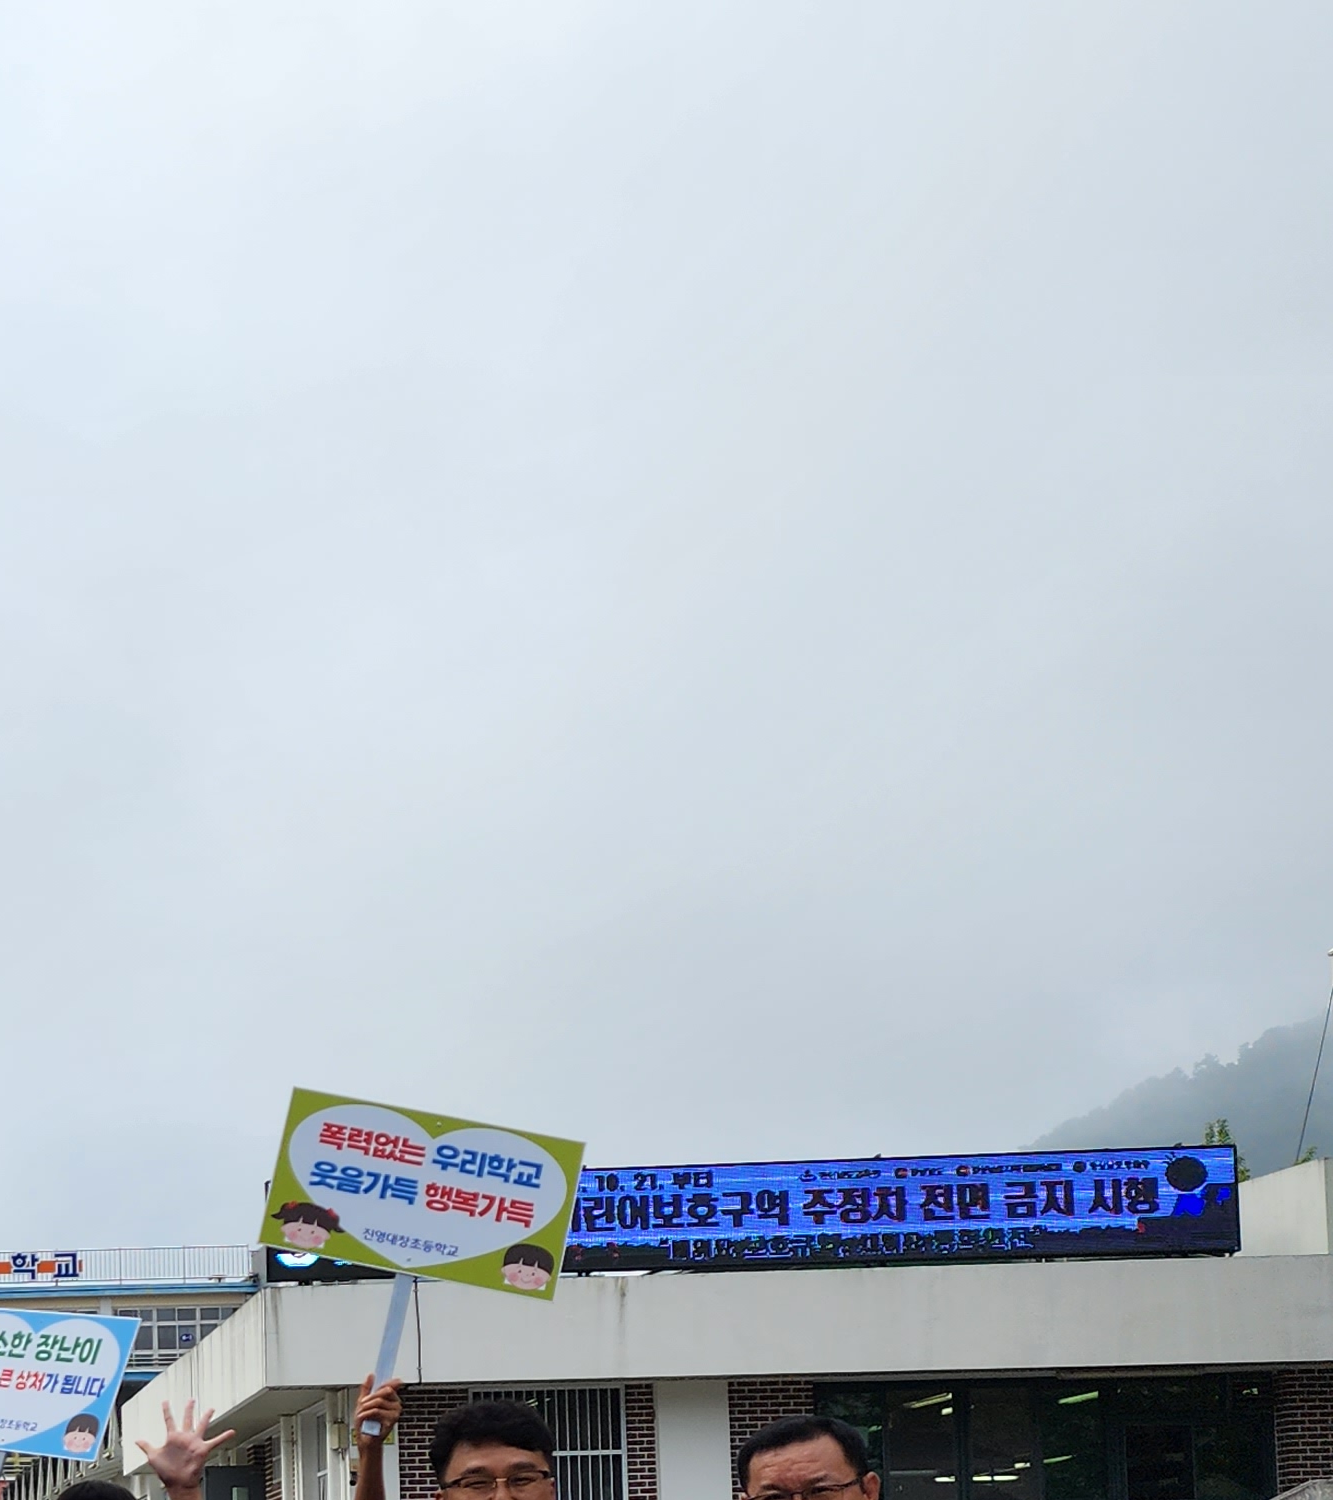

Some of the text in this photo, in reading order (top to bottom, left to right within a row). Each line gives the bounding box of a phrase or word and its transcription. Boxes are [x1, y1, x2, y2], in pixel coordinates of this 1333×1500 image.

[319, 1122, 543, 1189] 폭력없는 우리학교
[309, 1161, 535, 1228] 웃음가득 행복가득
[672, 1170, 714, 1189] 부터
[803, 1186, 907, 1224] 주정차
[920, 1182, 991, 1221] 전면
[1004, 1180, 1074, 1218] 금지
[1088, 1176, 1159, 1215] 시행
[362, 1227, 459, 1257] 진영대창초등학교
[34, 1333, 103, 1365] 장난이
[60, 1374, 105, 1398] 됩니다
